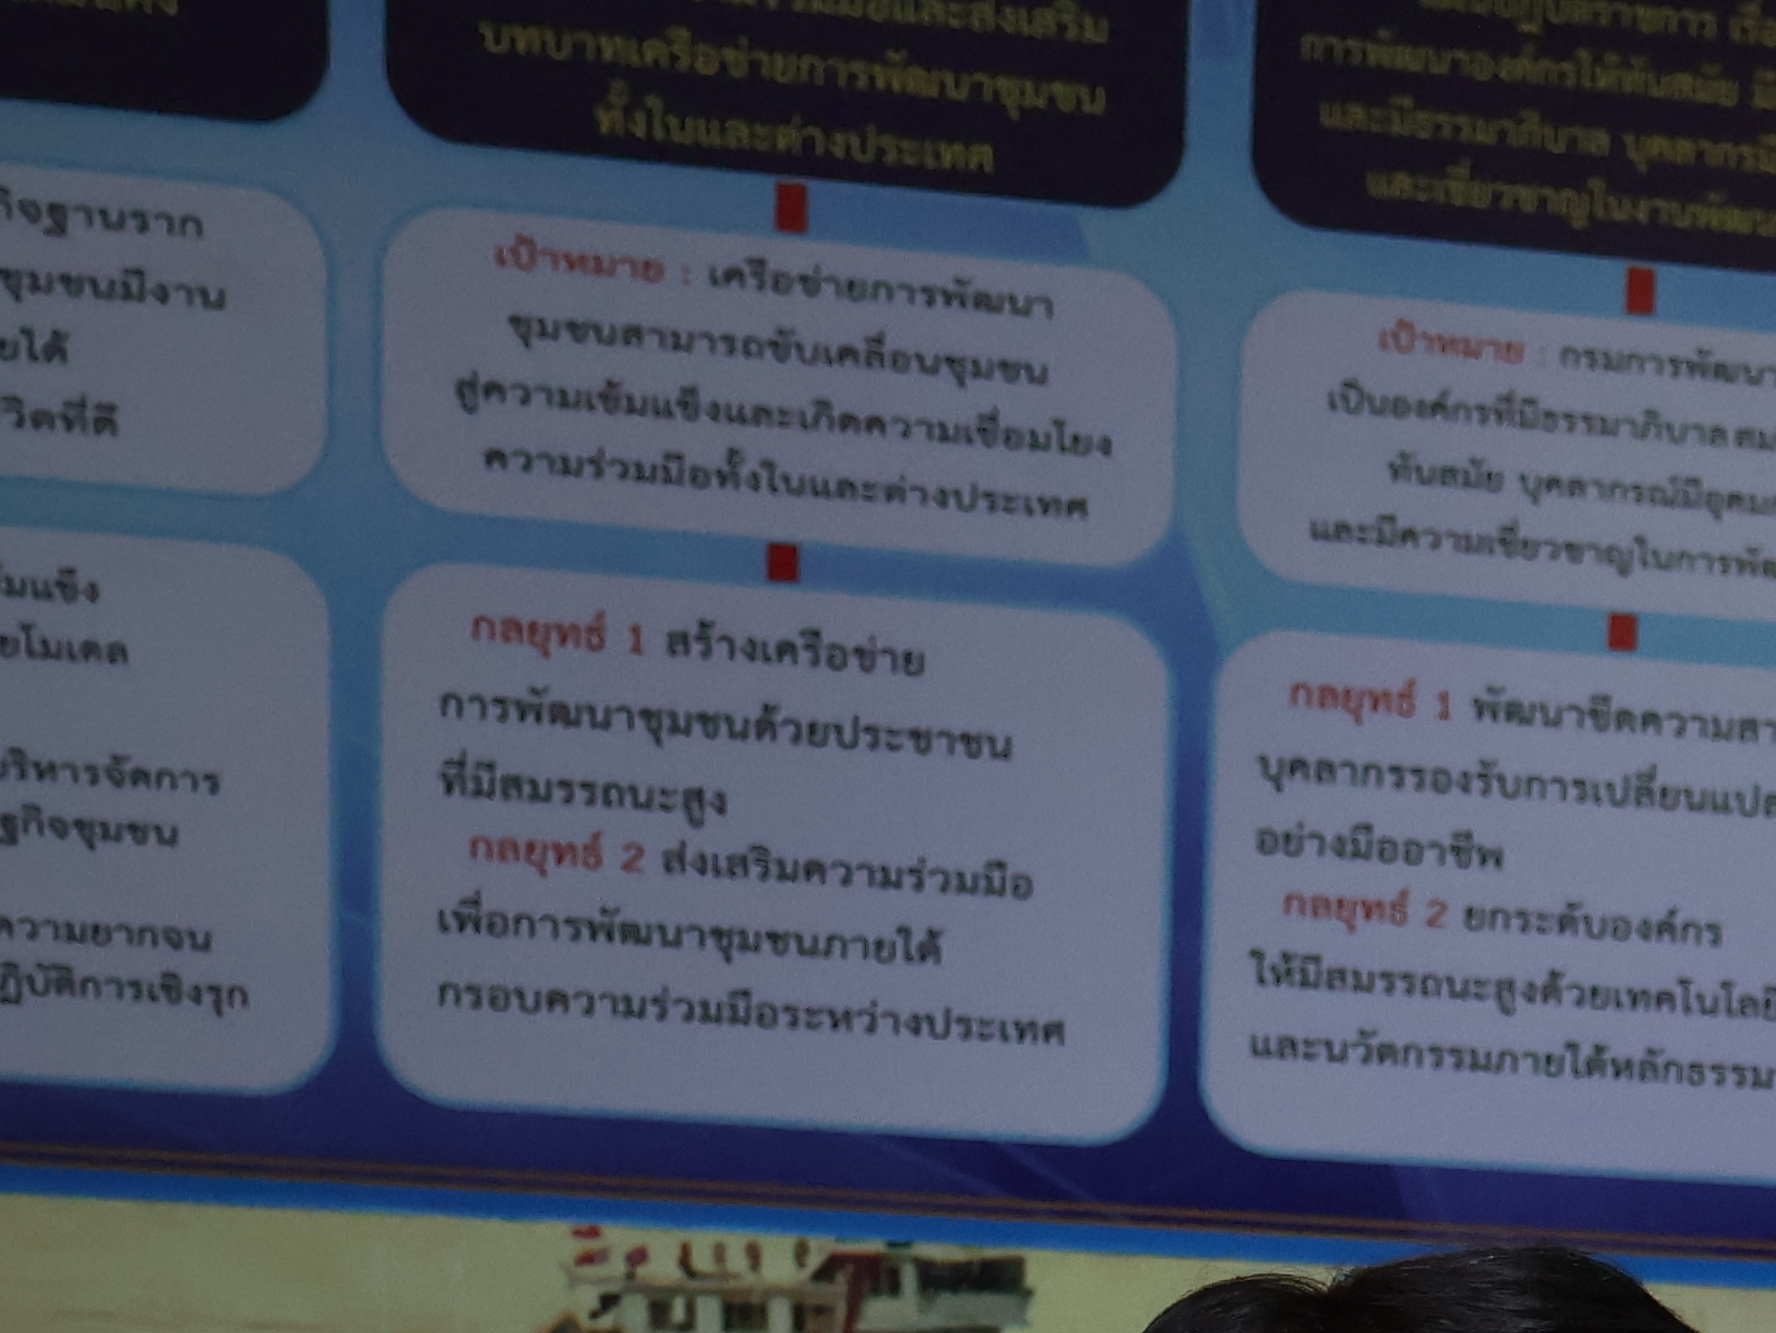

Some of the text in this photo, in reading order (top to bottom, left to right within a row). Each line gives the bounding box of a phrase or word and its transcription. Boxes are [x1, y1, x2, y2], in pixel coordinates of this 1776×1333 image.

[495, 235, 664, 283] เป้าหมาย
[707, 258, 1054, 320] เครือข่ายการพัฒนา
[507, 313, 1049, 389] ชุมชนสามารถขับเคลื่อนชุมชน
[1379, 319, 1524, 364] เป้าหมาย
[482, 447, 1089, 520] ความร่วมมือทั้งในและต่างประเทศ
[1386, 450, 1504, 492] ทันสมัย
[472, 611, 926, 679] กลยุทธ์ 1 สร้างเครือข่าย
[439, 686, 1013, 762] การพัฒนาชุมชนด้วยประชาชน
[1290, 678, 1417, 725] กลยุทธ์
[1438, 692, 1451, 721] 1
[437, 749, 728, 829] ที่มีสมรรถนะสูง
[469, 832, 1034, 902] กลยุทธ์ 2 ส่งเสริมความร่วมมือ
[1255, 821, 1505, 872] อย่างมืออาชีพ
[437, 890, 945, 966] เพื่อการพัฒนาชุมชนภายใต้
[1283, 889, 1723, 949] กลยุทธ์ 2 ยกระดับองค์กร
[437, 980, 1066, 1047] กรอบความร่วมมือระหว่างประเทศ
